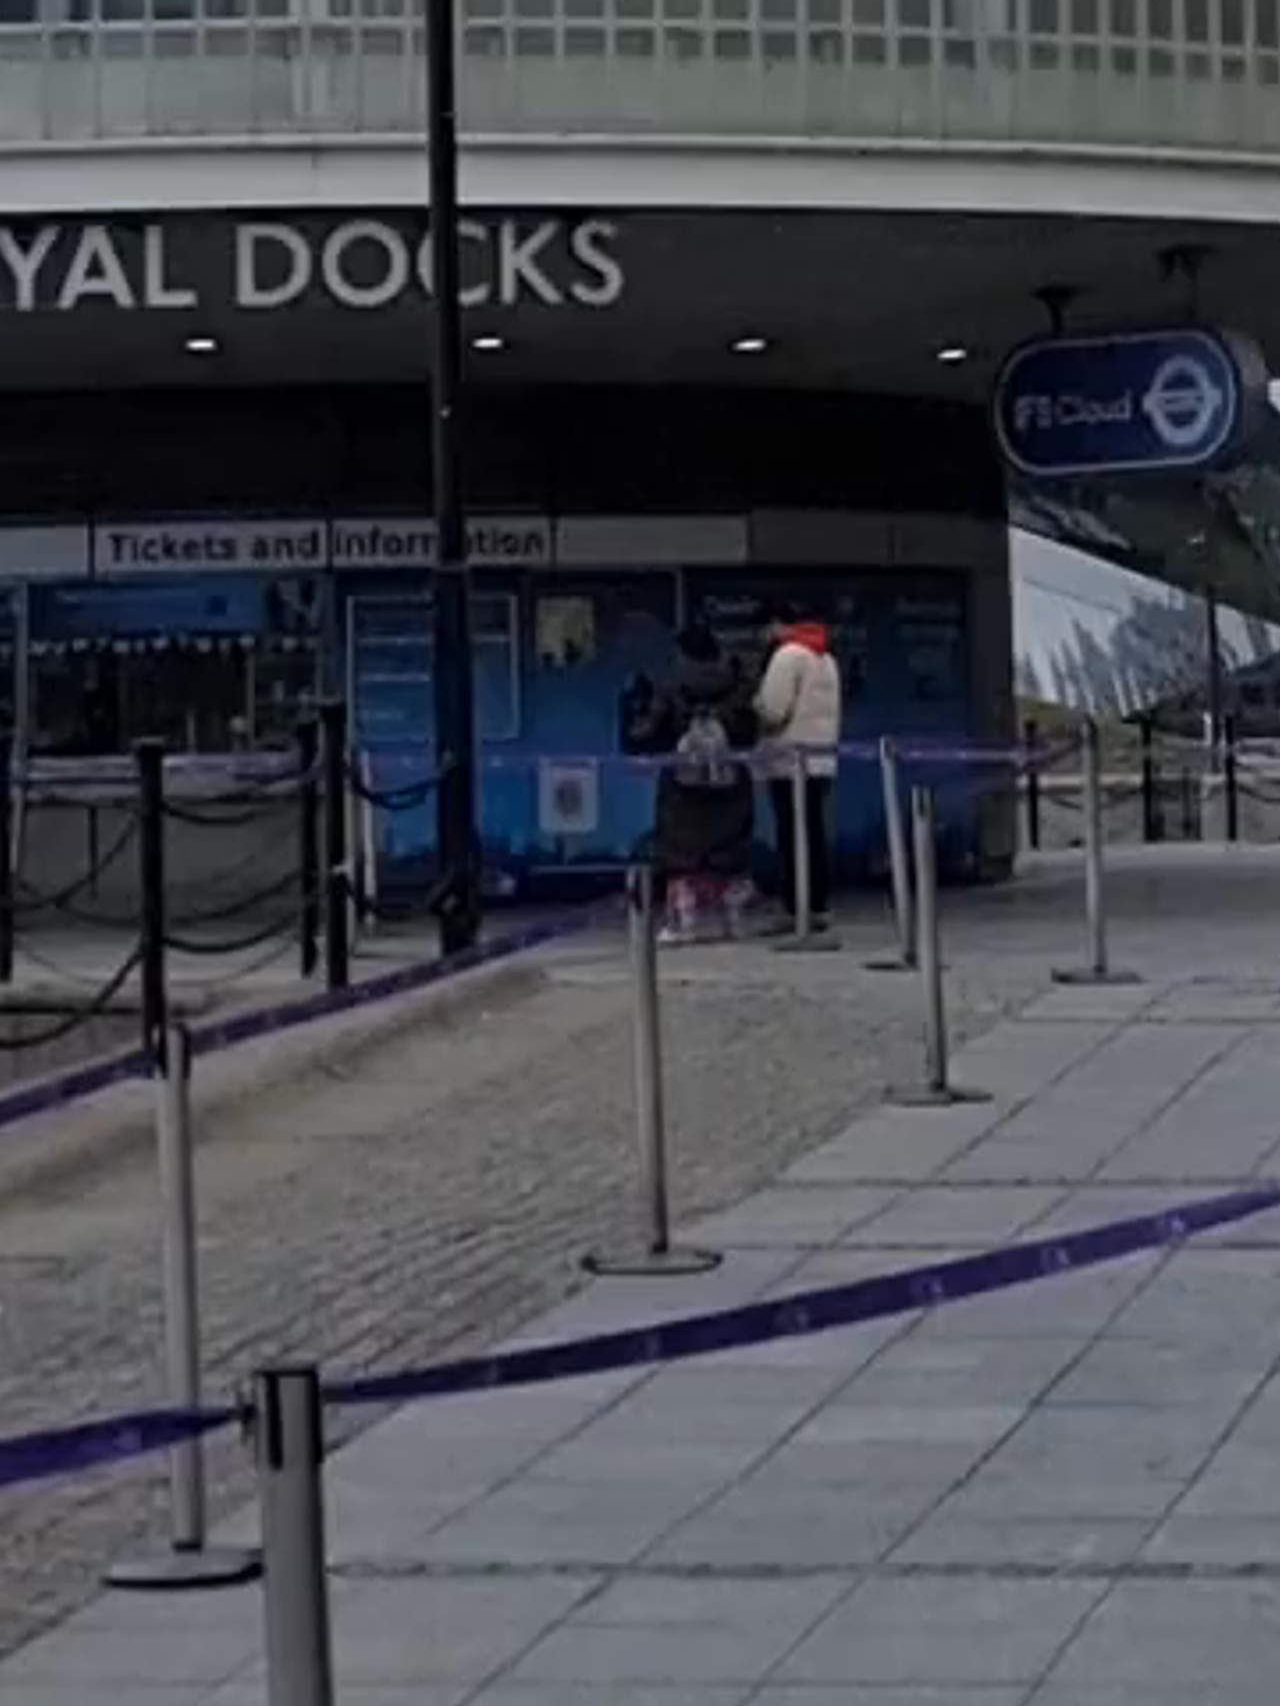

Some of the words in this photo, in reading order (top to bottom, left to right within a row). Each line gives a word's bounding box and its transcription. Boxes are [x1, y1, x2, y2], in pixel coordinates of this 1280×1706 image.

[237, 218, 623, 307] DOCKS
[108, 530, 238, 563] Tickets
[251, 528, 320, 560] and
